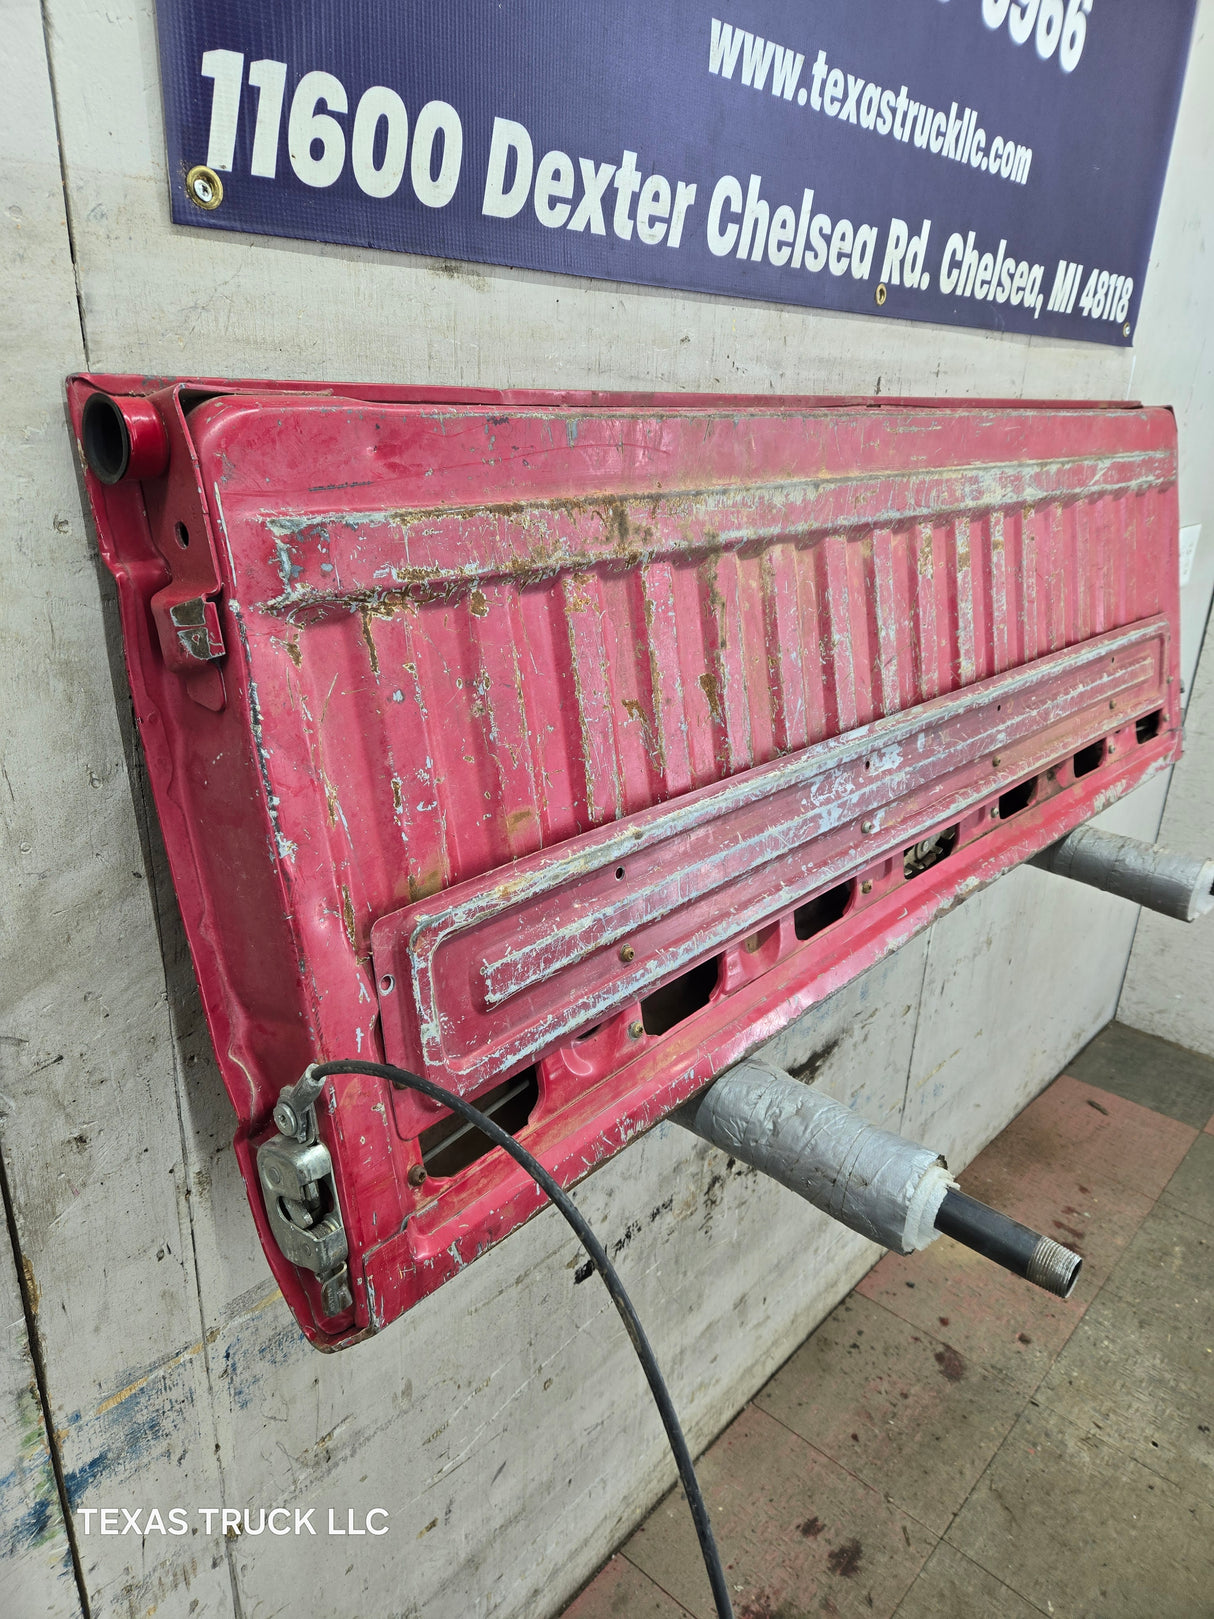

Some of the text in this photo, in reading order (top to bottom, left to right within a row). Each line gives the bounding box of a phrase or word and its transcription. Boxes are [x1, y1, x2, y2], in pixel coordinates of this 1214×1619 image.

[200, 48, 1133, 324] 11600 Dexter Chelsea Rd. Chelsea, MI 48118
[709, 18, 1033, 184] www.texastruckllc.com
